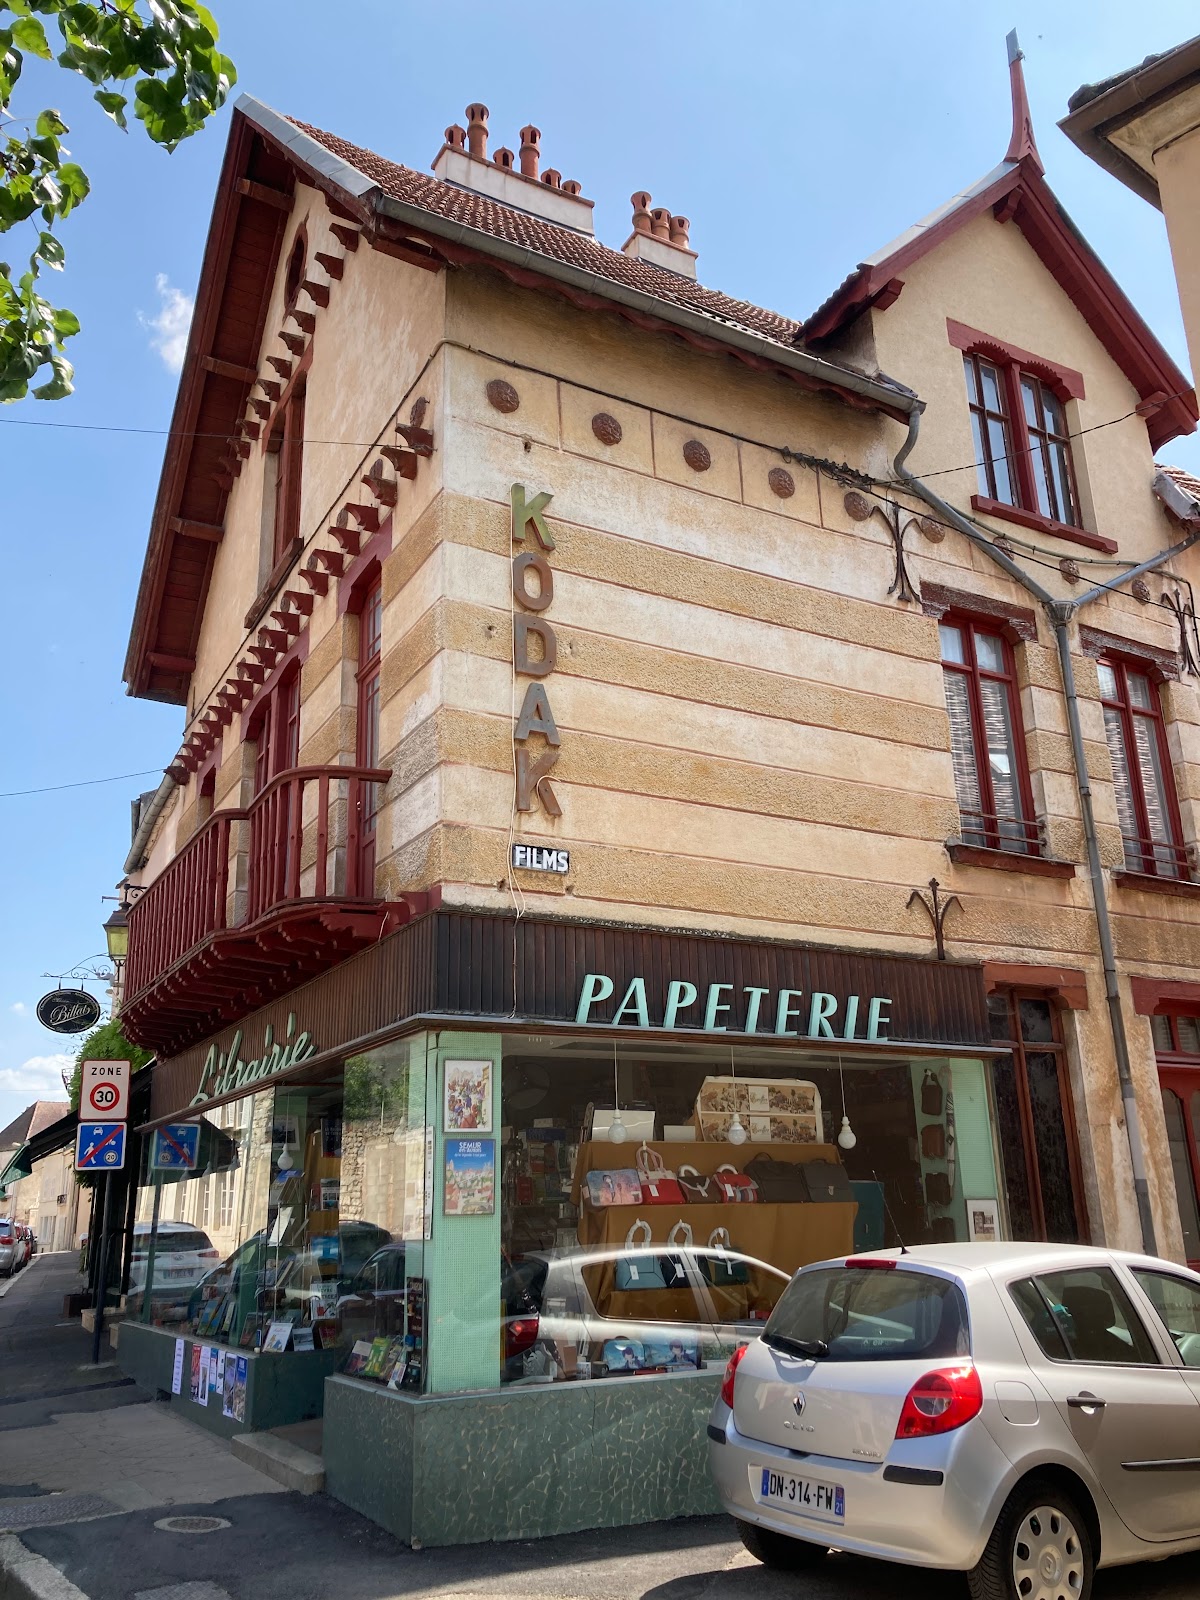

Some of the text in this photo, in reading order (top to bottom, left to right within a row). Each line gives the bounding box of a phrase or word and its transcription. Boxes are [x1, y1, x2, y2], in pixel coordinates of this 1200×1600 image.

[511, 482, 562, 816] KODAK
[515, 845, 569, 872] FILMS
[575, 973, 893, 1042] PAPETERIE
[91, 1067, 122, 1076] ZONE
[189, 1012, 317, 1107] Librairie
[95, 1090, 114, 1103] 30
[783, 1421, 815, 1433] CLIO
[769, 1473, 833, 1510] DN-314-FW
[835, 1502, 843, 1514] 21
